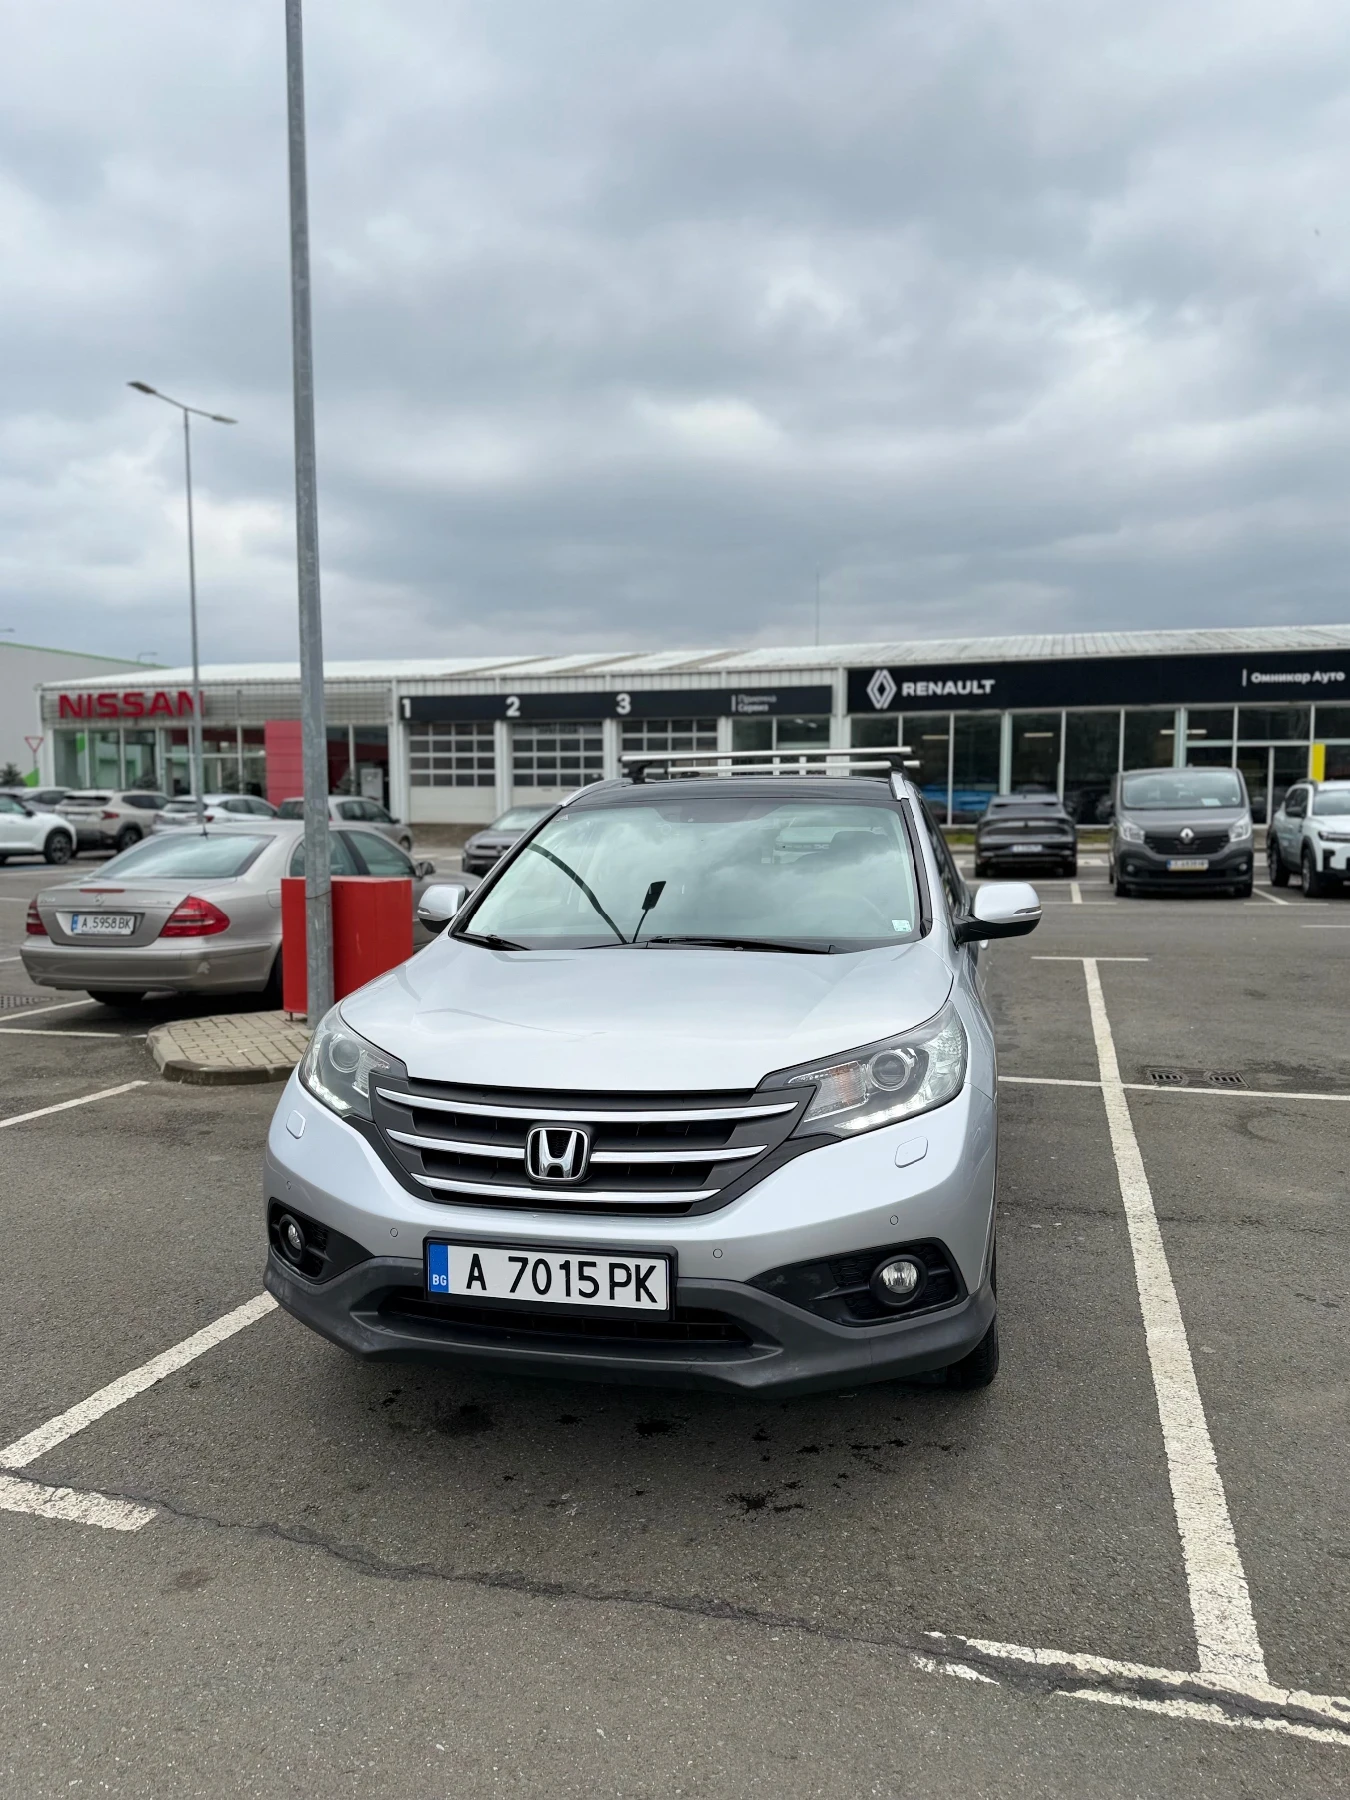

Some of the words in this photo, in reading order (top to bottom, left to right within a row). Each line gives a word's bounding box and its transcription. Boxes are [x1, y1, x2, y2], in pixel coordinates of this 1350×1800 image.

[901, 679, 996, 697] RENAULT
[1312, 671, 1346, 684] Ауто
[58, 690, 205, 718] NISSAN
[402, 698, 411, 719] 1
[505, 696, 521, 717] 2
[616, 693, 632, 715] 3
[432, 1274, 448, 1286] BG
[466, 1253, 487, 1291] A
